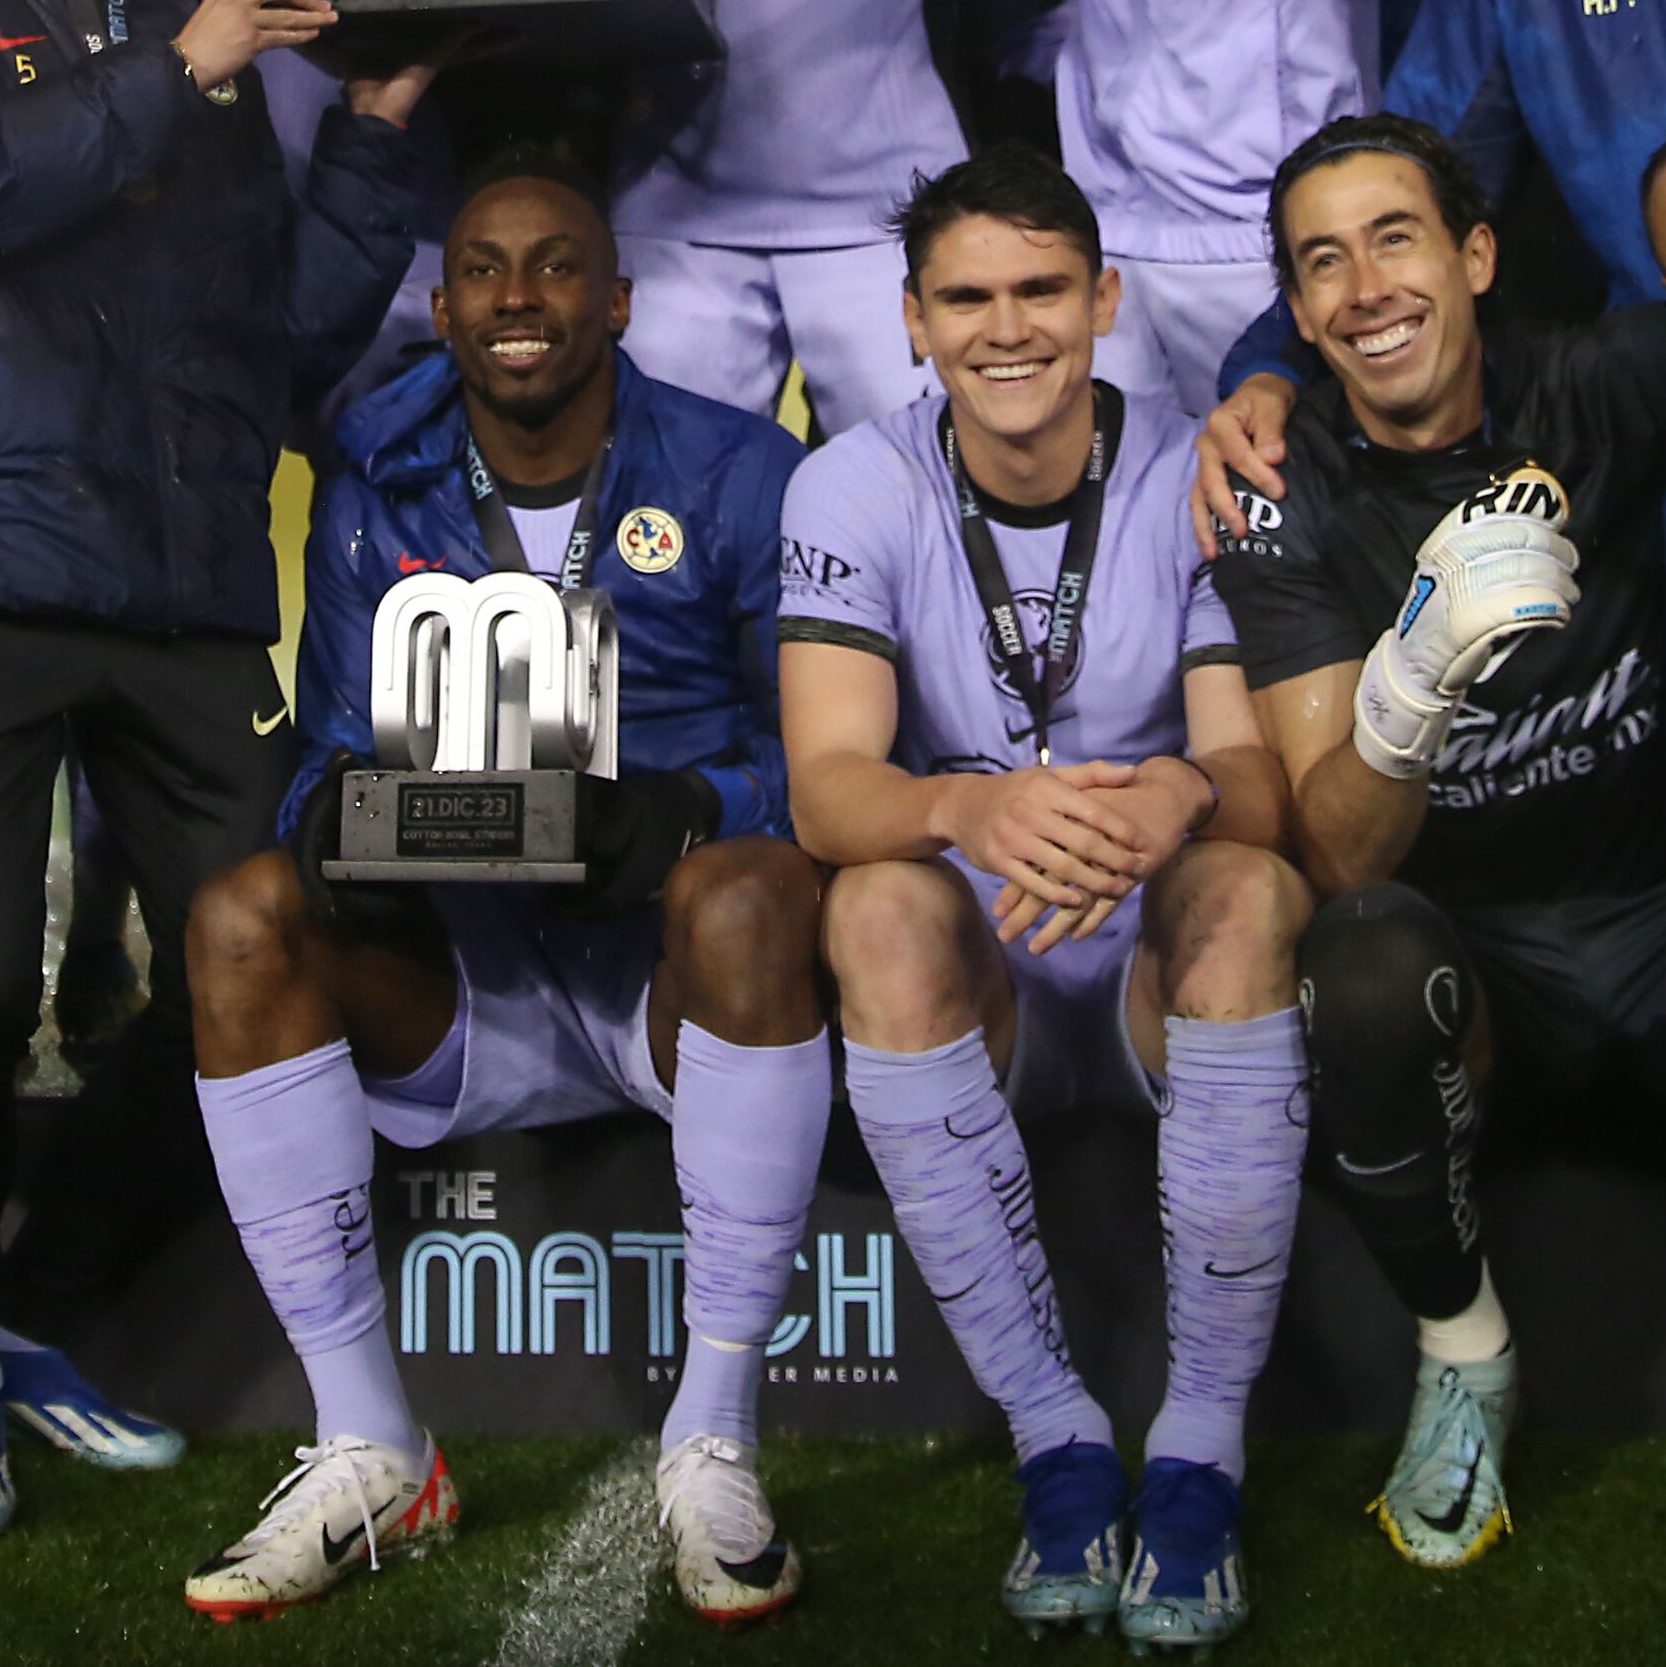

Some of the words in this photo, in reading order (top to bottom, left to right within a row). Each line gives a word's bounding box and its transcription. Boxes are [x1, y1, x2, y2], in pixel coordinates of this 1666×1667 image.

[16, 53, 37, 85] 5
[992, 605, 1022, 656] SOCCER
[1050, 572, 1082, 656] MATCH
[412, 796, 508, 818] 21.DIC.23
[406, 1171, 497, 1220] THE
[400, 1232, 895, 1357] MATH
[646, 1367, 676, 1383] BY
[814, 1367, 900, 1383] MEDIA
